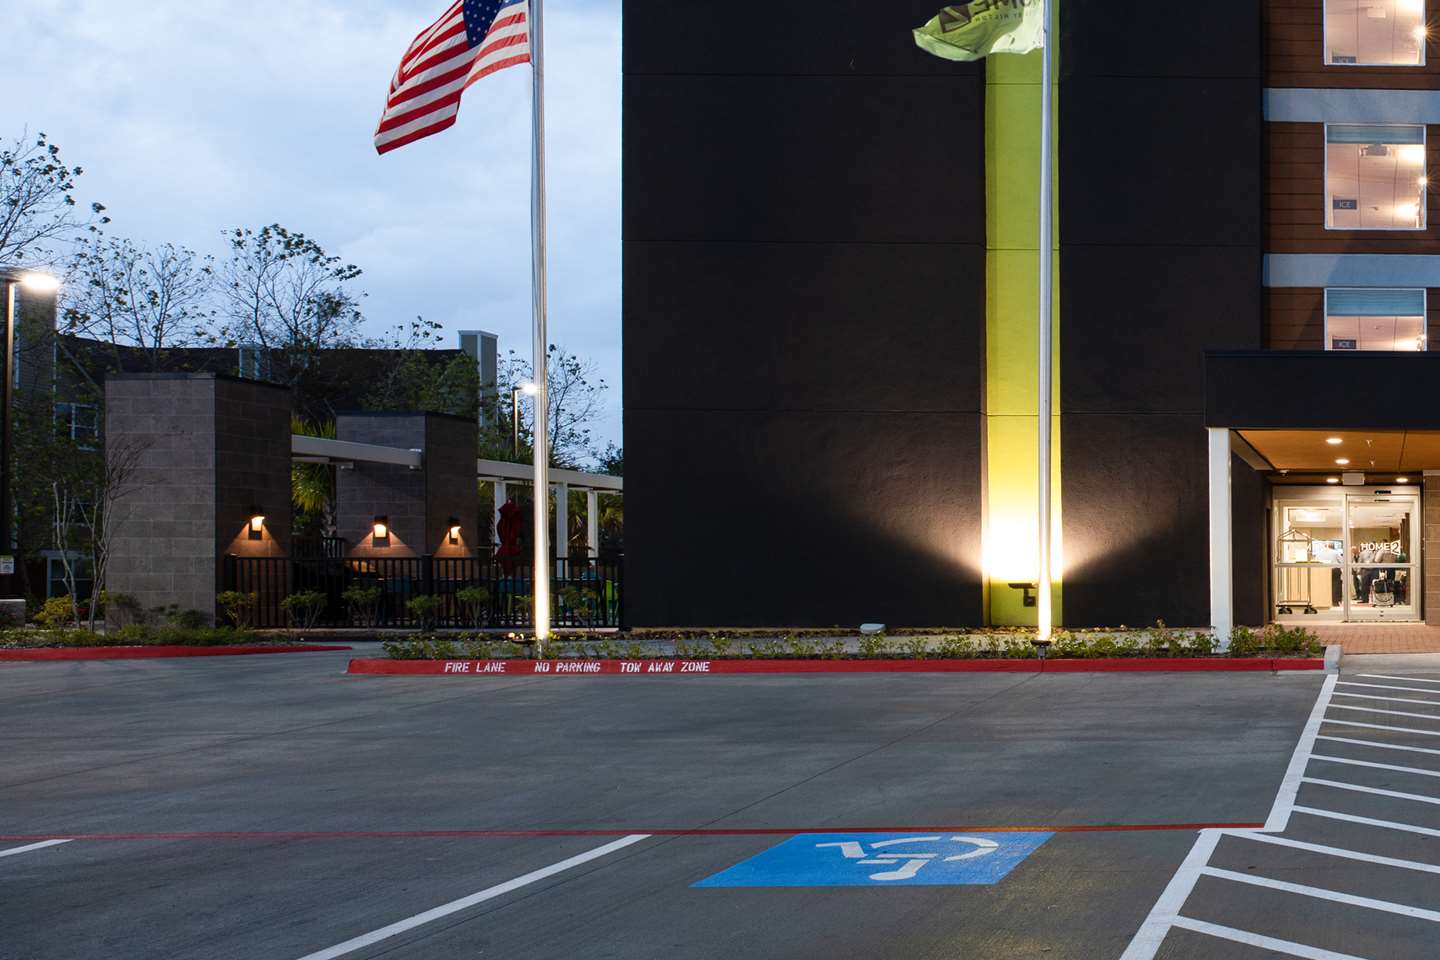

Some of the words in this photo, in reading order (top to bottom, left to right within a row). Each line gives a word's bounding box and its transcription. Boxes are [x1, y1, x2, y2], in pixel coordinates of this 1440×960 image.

[444, 662, 470, 673] FIRE
[476, 662, 507, 673] LANE
[534, 662, 550, 673] NO
[556, 662, 601, 673] PARKING
[620, 662, 642, 673] TOW
[647, 662, 675, 673] AWAY
[680, 661, 711, 672] ZONE
